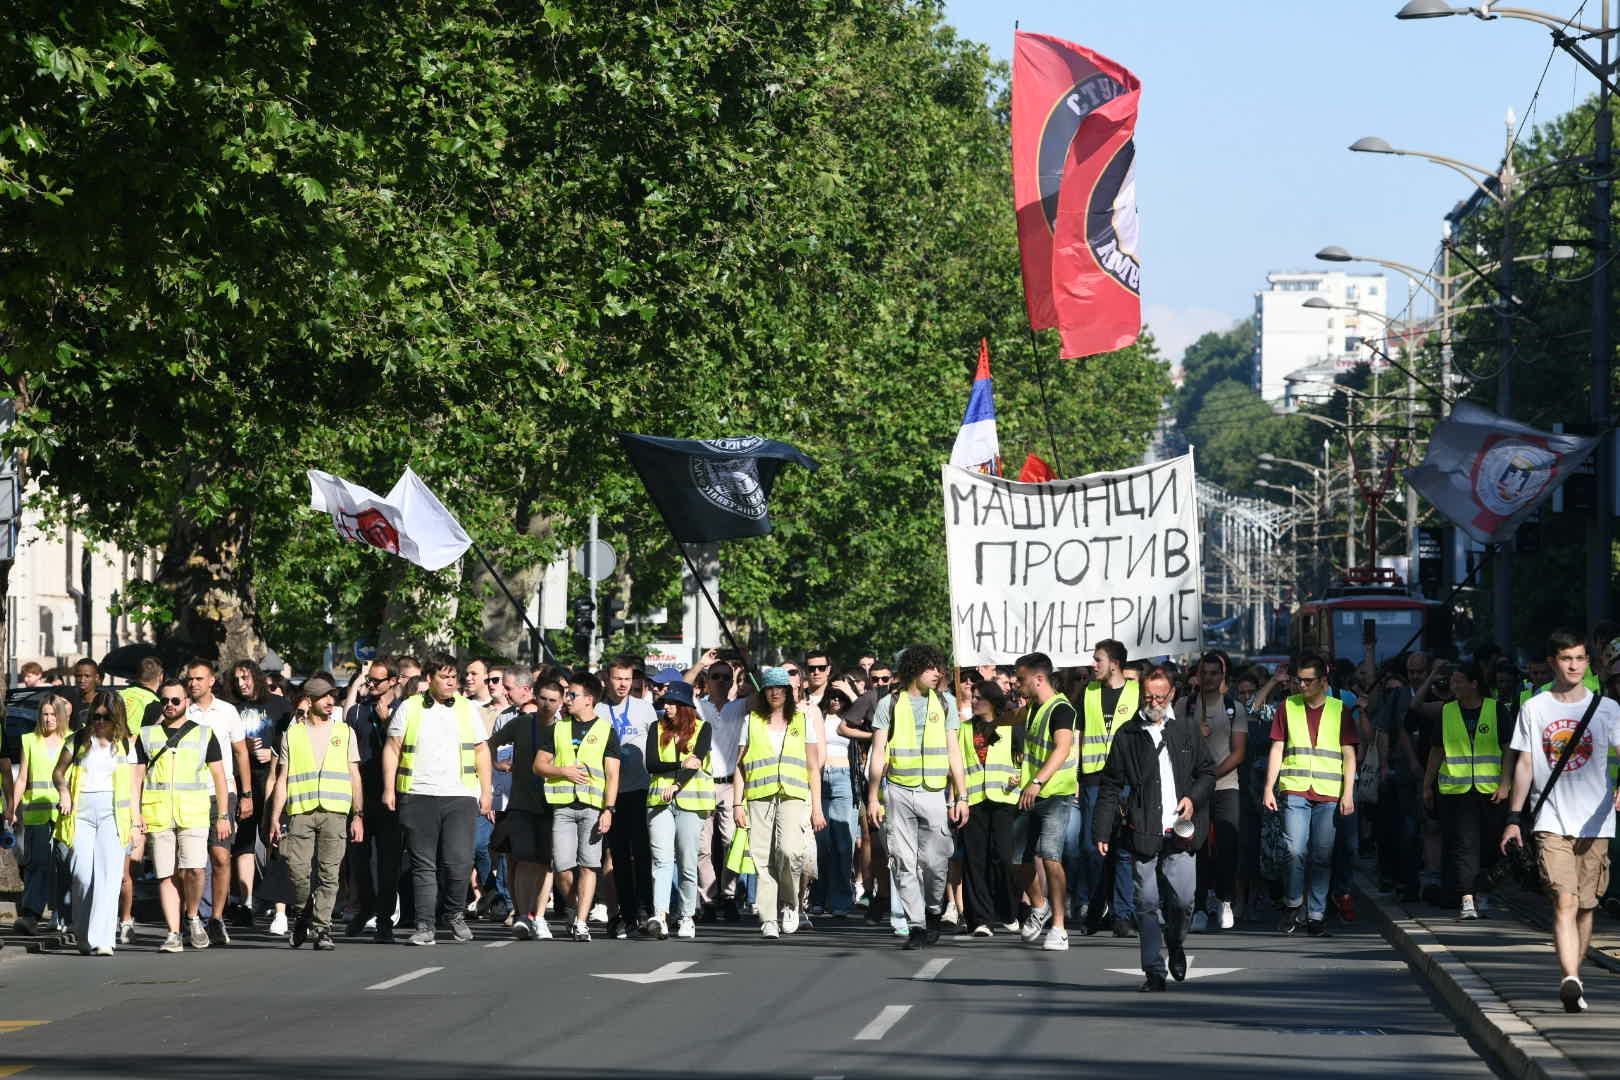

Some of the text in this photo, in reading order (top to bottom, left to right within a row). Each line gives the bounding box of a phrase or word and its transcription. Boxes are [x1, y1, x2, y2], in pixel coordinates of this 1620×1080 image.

[950, 467, 1178, 529] МАШИНЦИ
[975, 527, 1191, 586] ПРОТИВ
[956, 588, 1198, 655] МАШИНЕРИЈЕ
